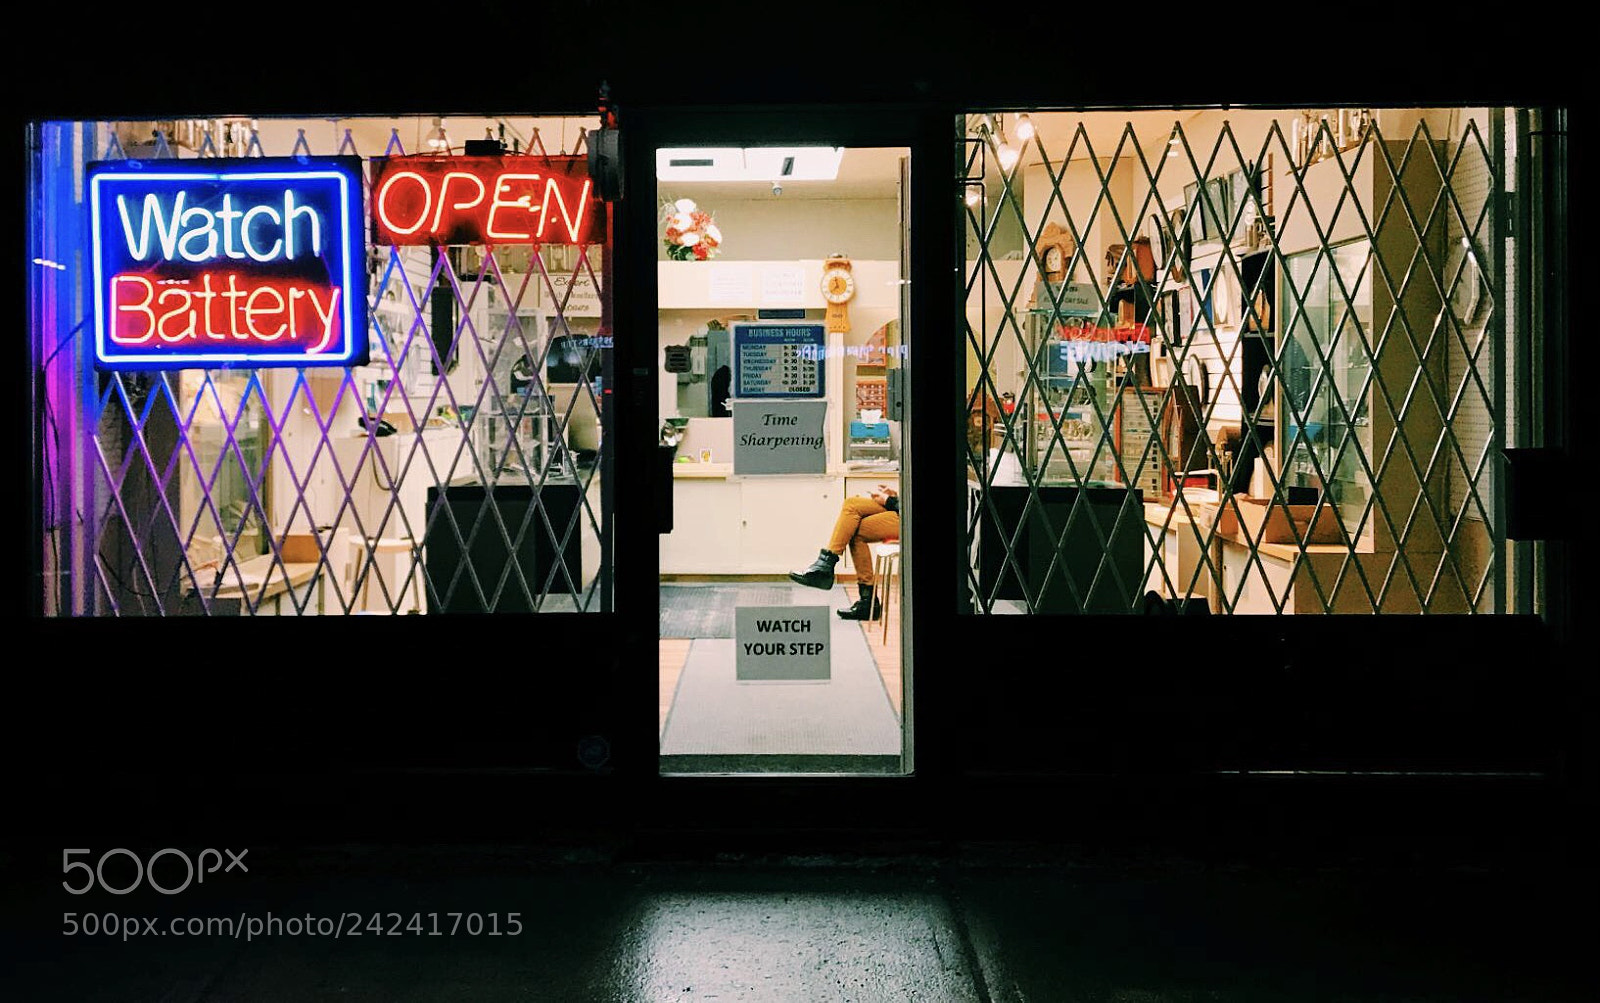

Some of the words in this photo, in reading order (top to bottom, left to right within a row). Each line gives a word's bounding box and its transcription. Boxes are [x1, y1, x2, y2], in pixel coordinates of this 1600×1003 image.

[376, 170, 592, 243] OPEN
[117, 189, 321, 263] Watch
[110, 272, 341, 356] Battery
[748, 328, 785, 337] BUSINESS
[785, 328, 811, 337] HOURS
[761, 413, 798, 426] Time
[739, 432, 824, 450] Sharpening
[756, 620, 811, 633] WATCH
[743, 642, 785, 656] YOUR
[789, 642, 824, 656] STEP
